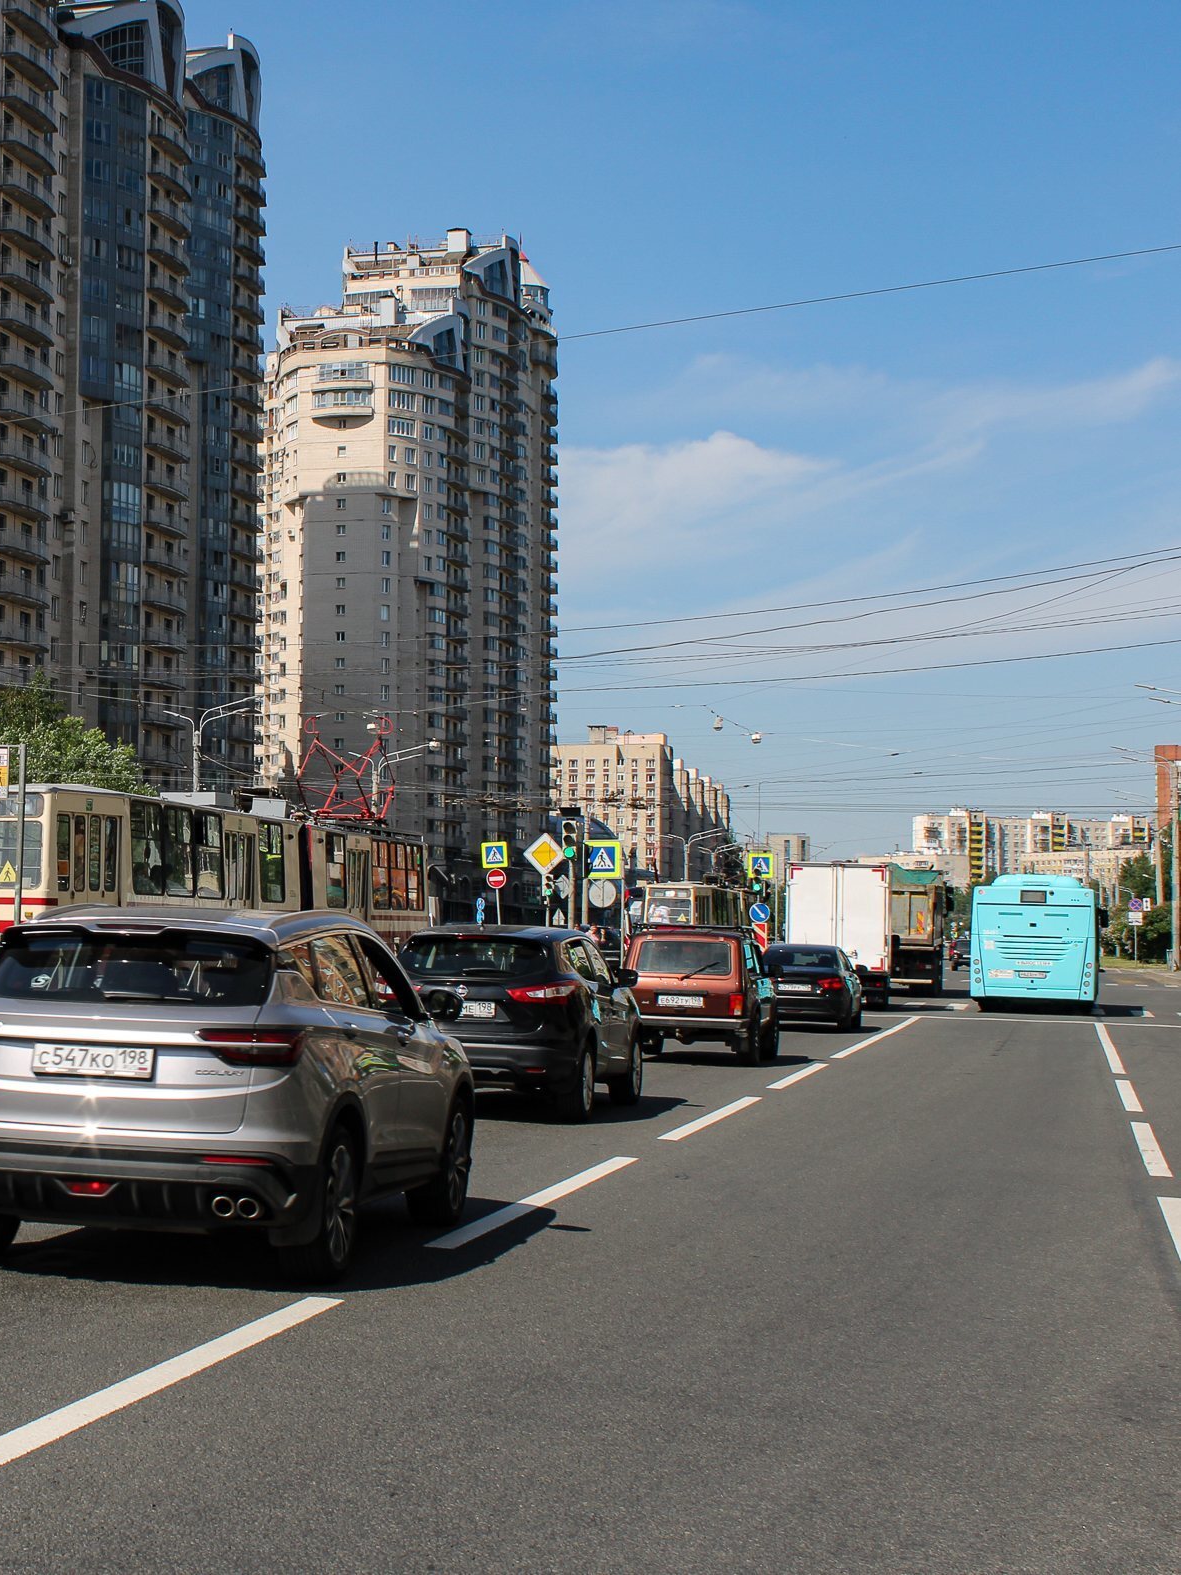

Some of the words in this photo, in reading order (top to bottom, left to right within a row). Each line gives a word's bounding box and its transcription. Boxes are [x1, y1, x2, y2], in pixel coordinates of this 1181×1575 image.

[660, 996, 688, 1004] Е692ТУ
[477, 1002, 493, 1012] 198
[38, 1047, 115, 1068] С547КО
[118, 1048, 148, 1065] 198
